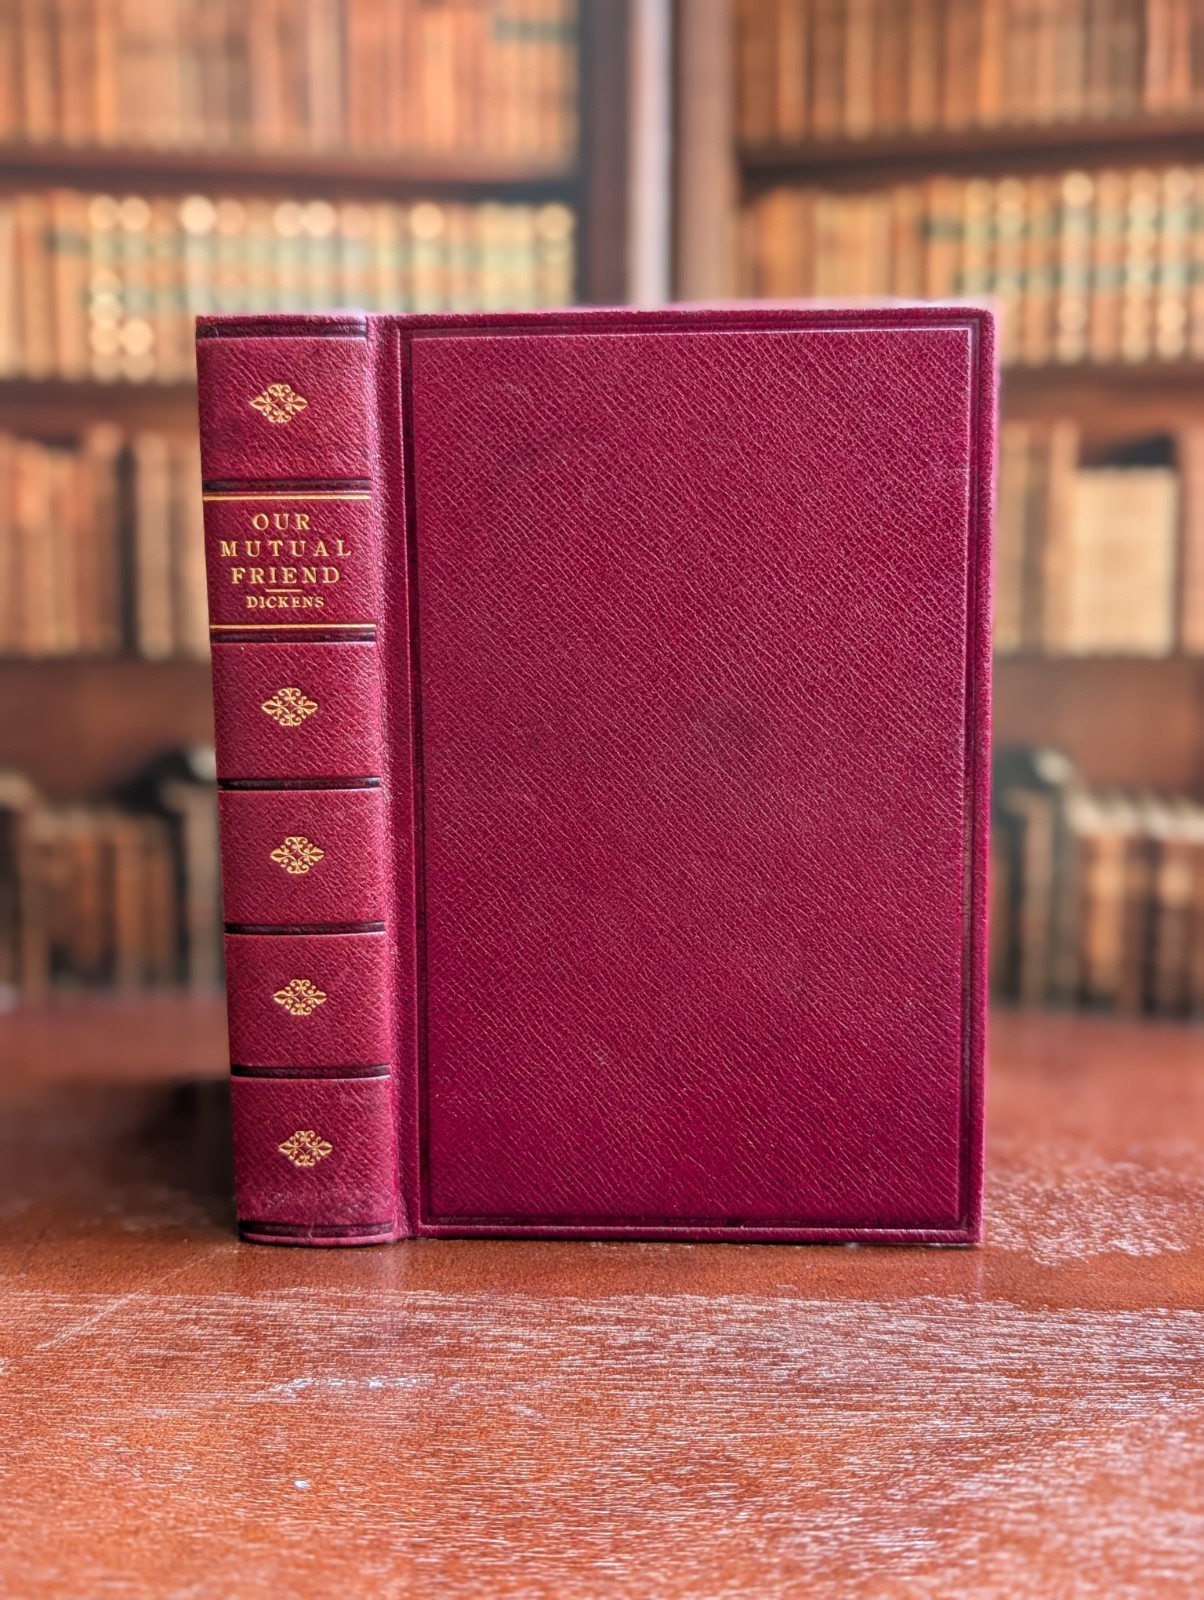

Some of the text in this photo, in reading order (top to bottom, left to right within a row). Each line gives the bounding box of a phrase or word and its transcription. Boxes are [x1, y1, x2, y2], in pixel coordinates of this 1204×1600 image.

[252, 513, 311, 530] OUR
[220, 540, 352, 557] MUTUAL
[231, 567, 340, 584] FRIEND
[246, 596, 324, 609] DICKENS
